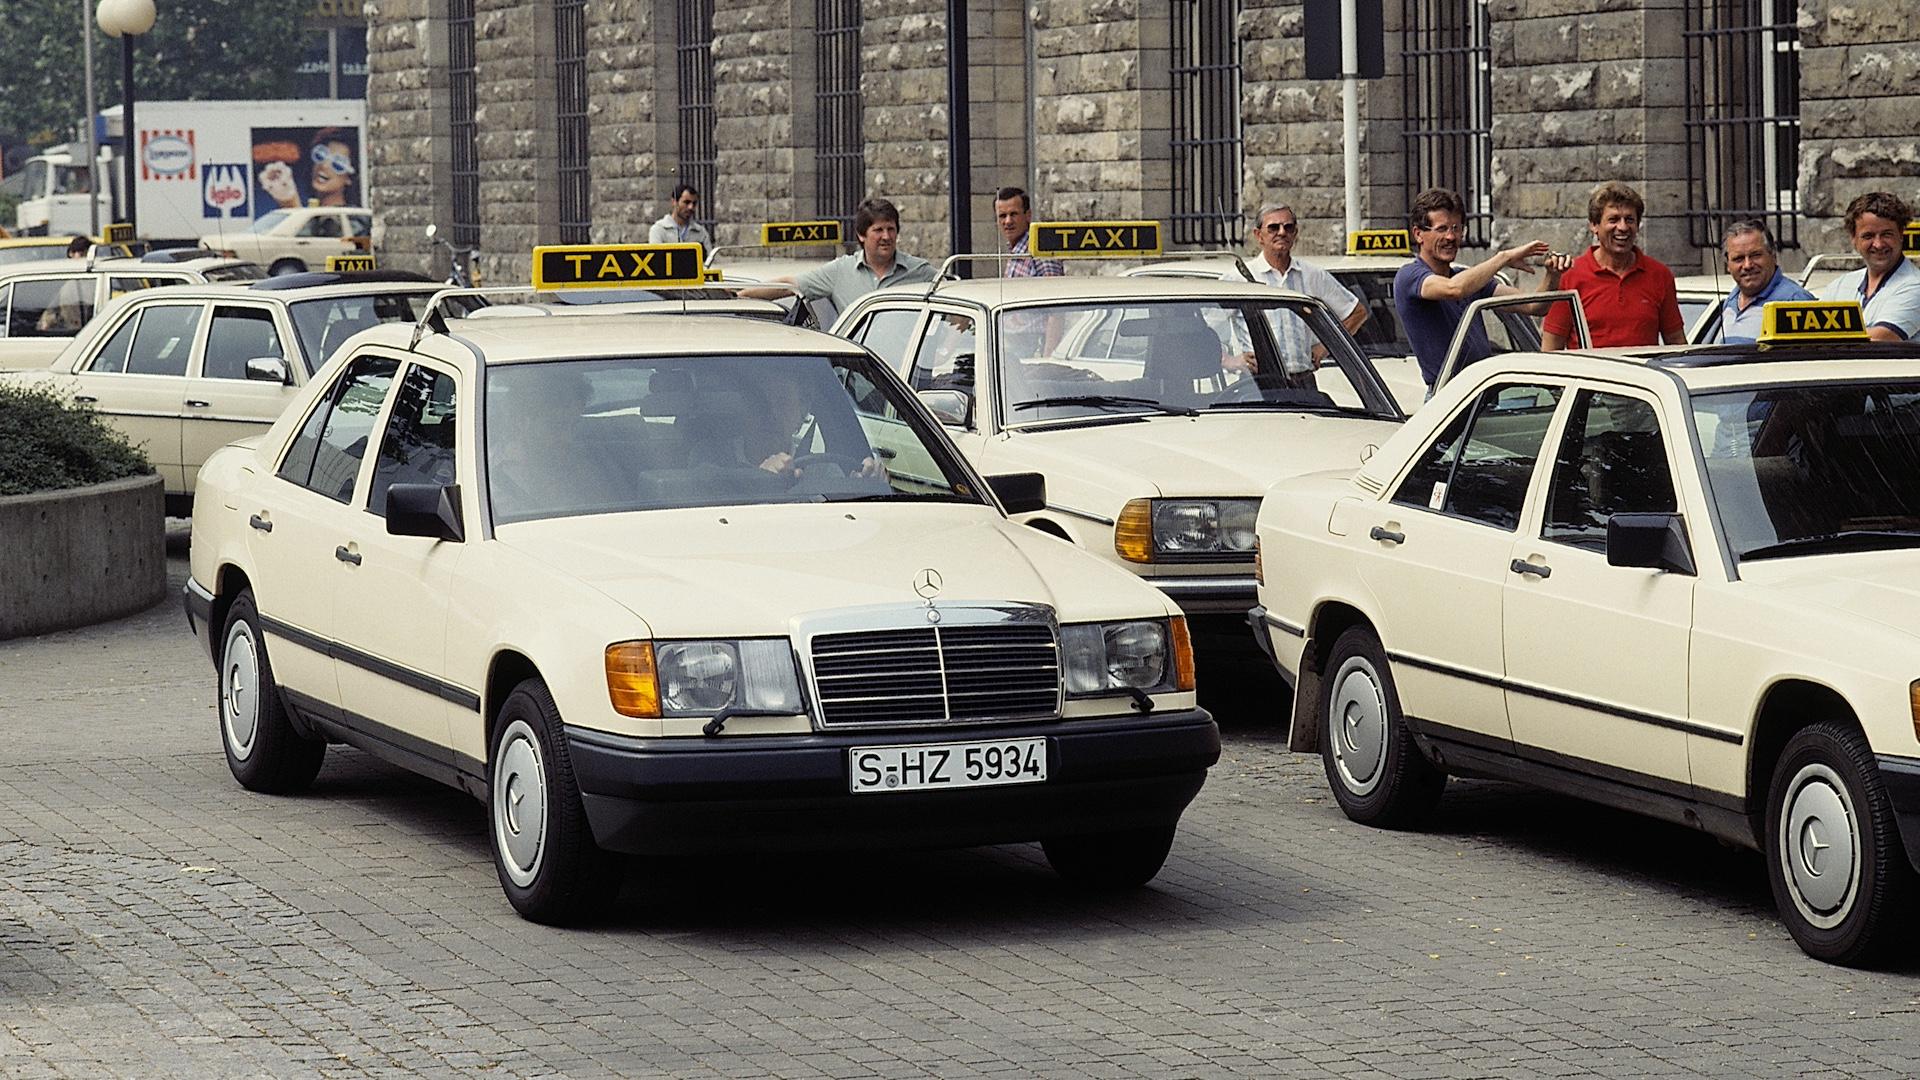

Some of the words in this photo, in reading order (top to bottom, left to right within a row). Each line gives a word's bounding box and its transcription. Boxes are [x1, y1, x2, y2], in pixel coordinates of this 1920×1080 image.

[777, 225, 828, 241] TAXI
[1055, 228, 1138, 249] TAXI
[1361, 235, 1401, 249] TAXI
[339, 260, 369, 272] TAXI
[564, 252, 672, 279] TAXI
[1785, 309, 1852, 330] TAXI
[858, 750, 951, 786] S-HZ
[965, 744, 1040, 781] 5934
